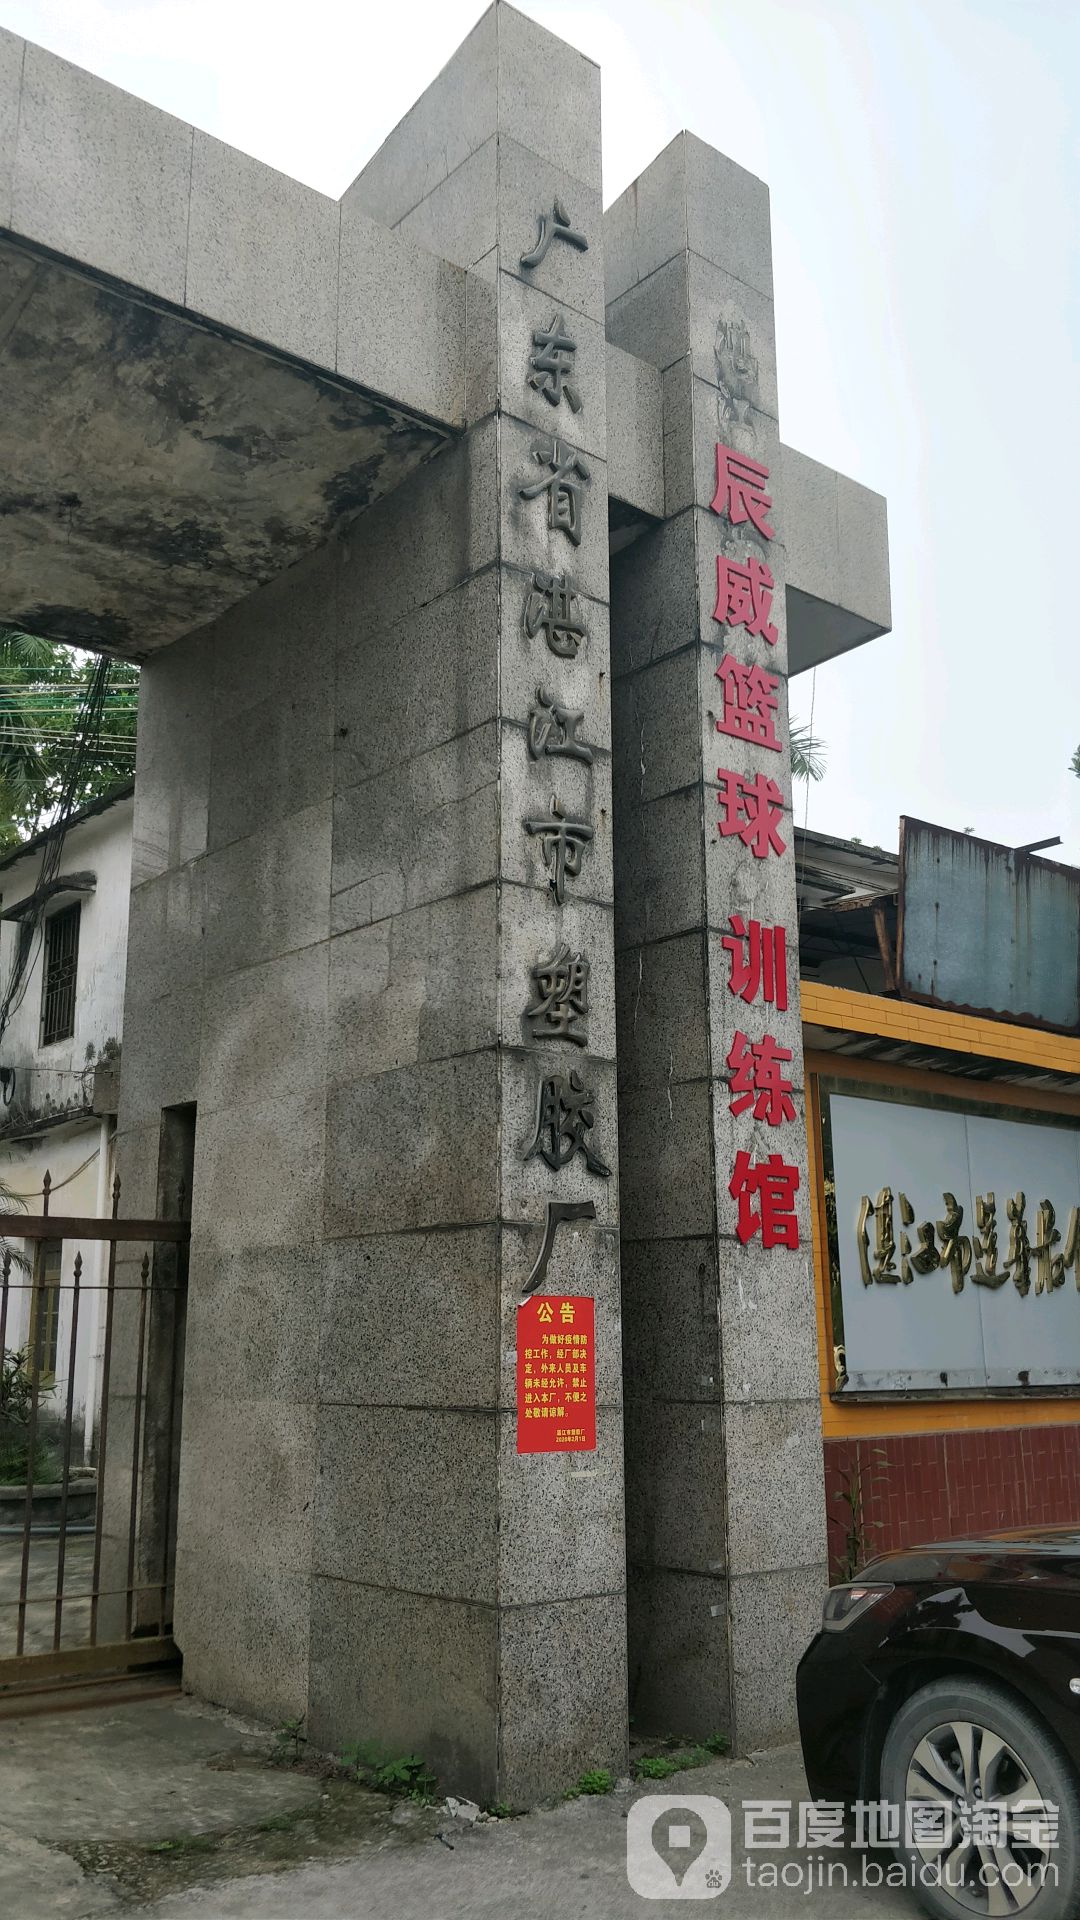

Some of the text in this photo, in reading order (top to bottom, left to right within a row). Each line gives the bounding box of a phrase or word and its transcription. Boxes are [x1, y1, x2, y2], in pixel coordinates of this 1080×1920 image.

[518, 199, 612, 1293] 广东省湛江市塑胶厂
[709, 442, 800, 1251] 辰威篮球训练馆
[536, 1302, 576, 1324] 公告
[541, 1334, 588, 1345] 为做好疫情防
[524, 1348, 587, 1360] 控工作，经厂部决
[524, 1363, 587, 1374] 定，外来人员及车
[524, 1377, 587, 1389] 辆未经允许，禁止
[524, 1392, 587, 1404] 进入本厂，不便之
